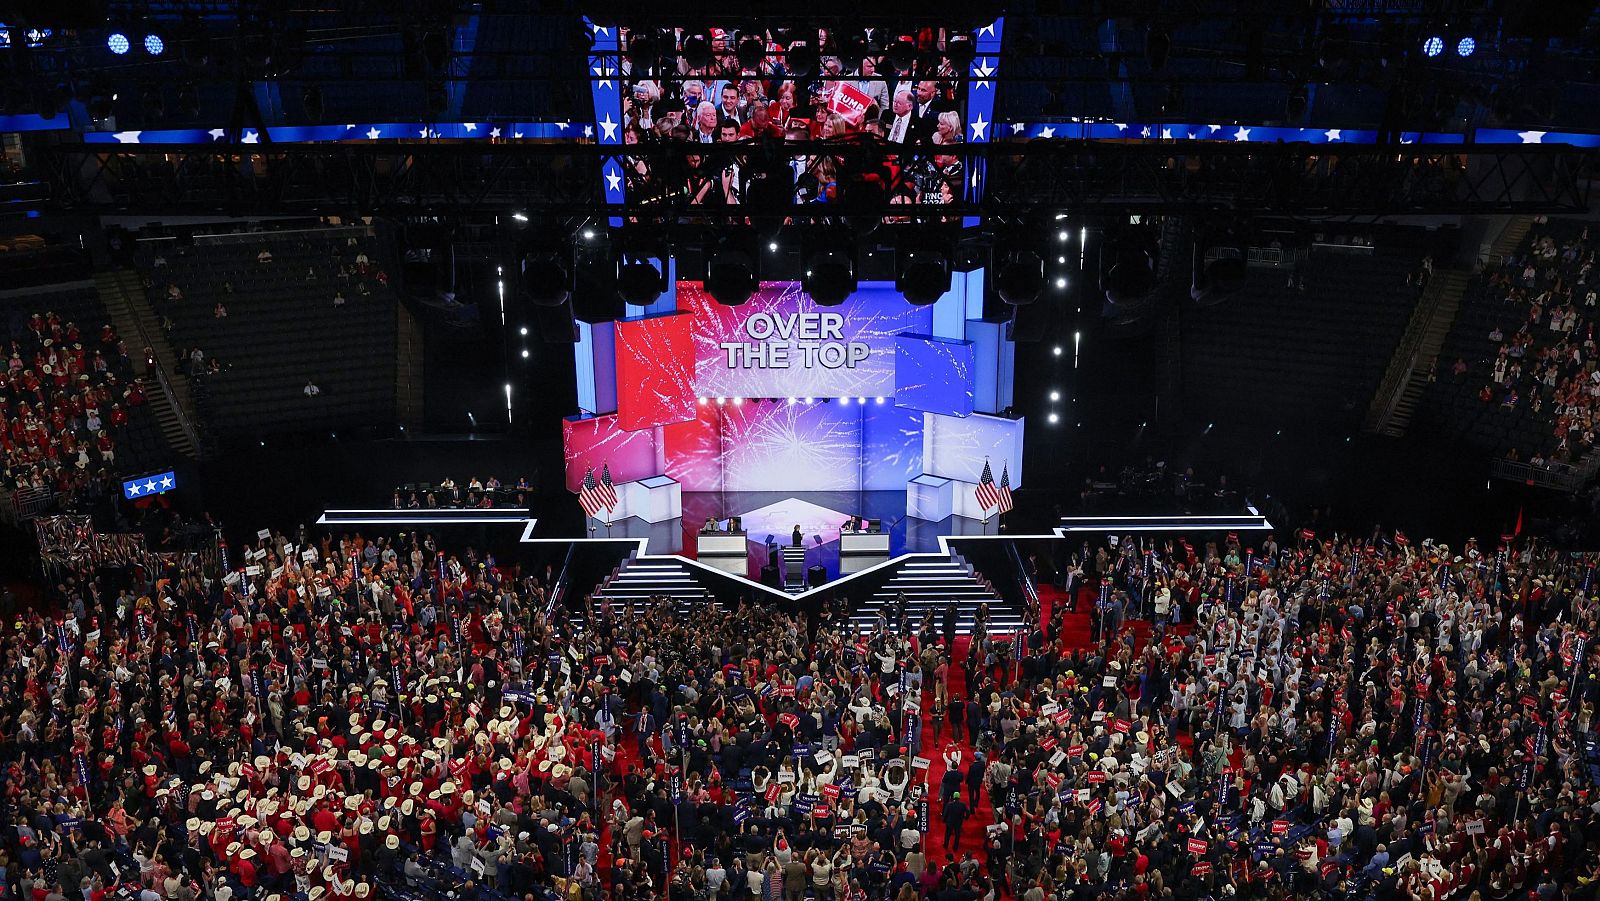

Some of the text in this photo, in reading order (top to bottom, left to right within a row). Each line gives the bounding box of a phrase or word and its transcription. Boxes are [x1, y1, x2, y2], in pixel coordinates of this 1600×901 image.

[746, 313, 844, 339] OVER
[721, 342, 870, 369] THE TOP
[138, 616, 146, 639] NEVADA
[1043, 738, 1056, 747] TRUMP
[313, 762, 328, 771] TRUMP
[453, 767, 467, 775] TRUMP
[767, 785, 777, 799] TRUMP
[1060, 793, 1073, 801] TRUMP
[1180, 805, 1194, 813] TRUMP
[734, 811, 746, 820] TRUMP
[331, 849, 346, 857] TRUMP
